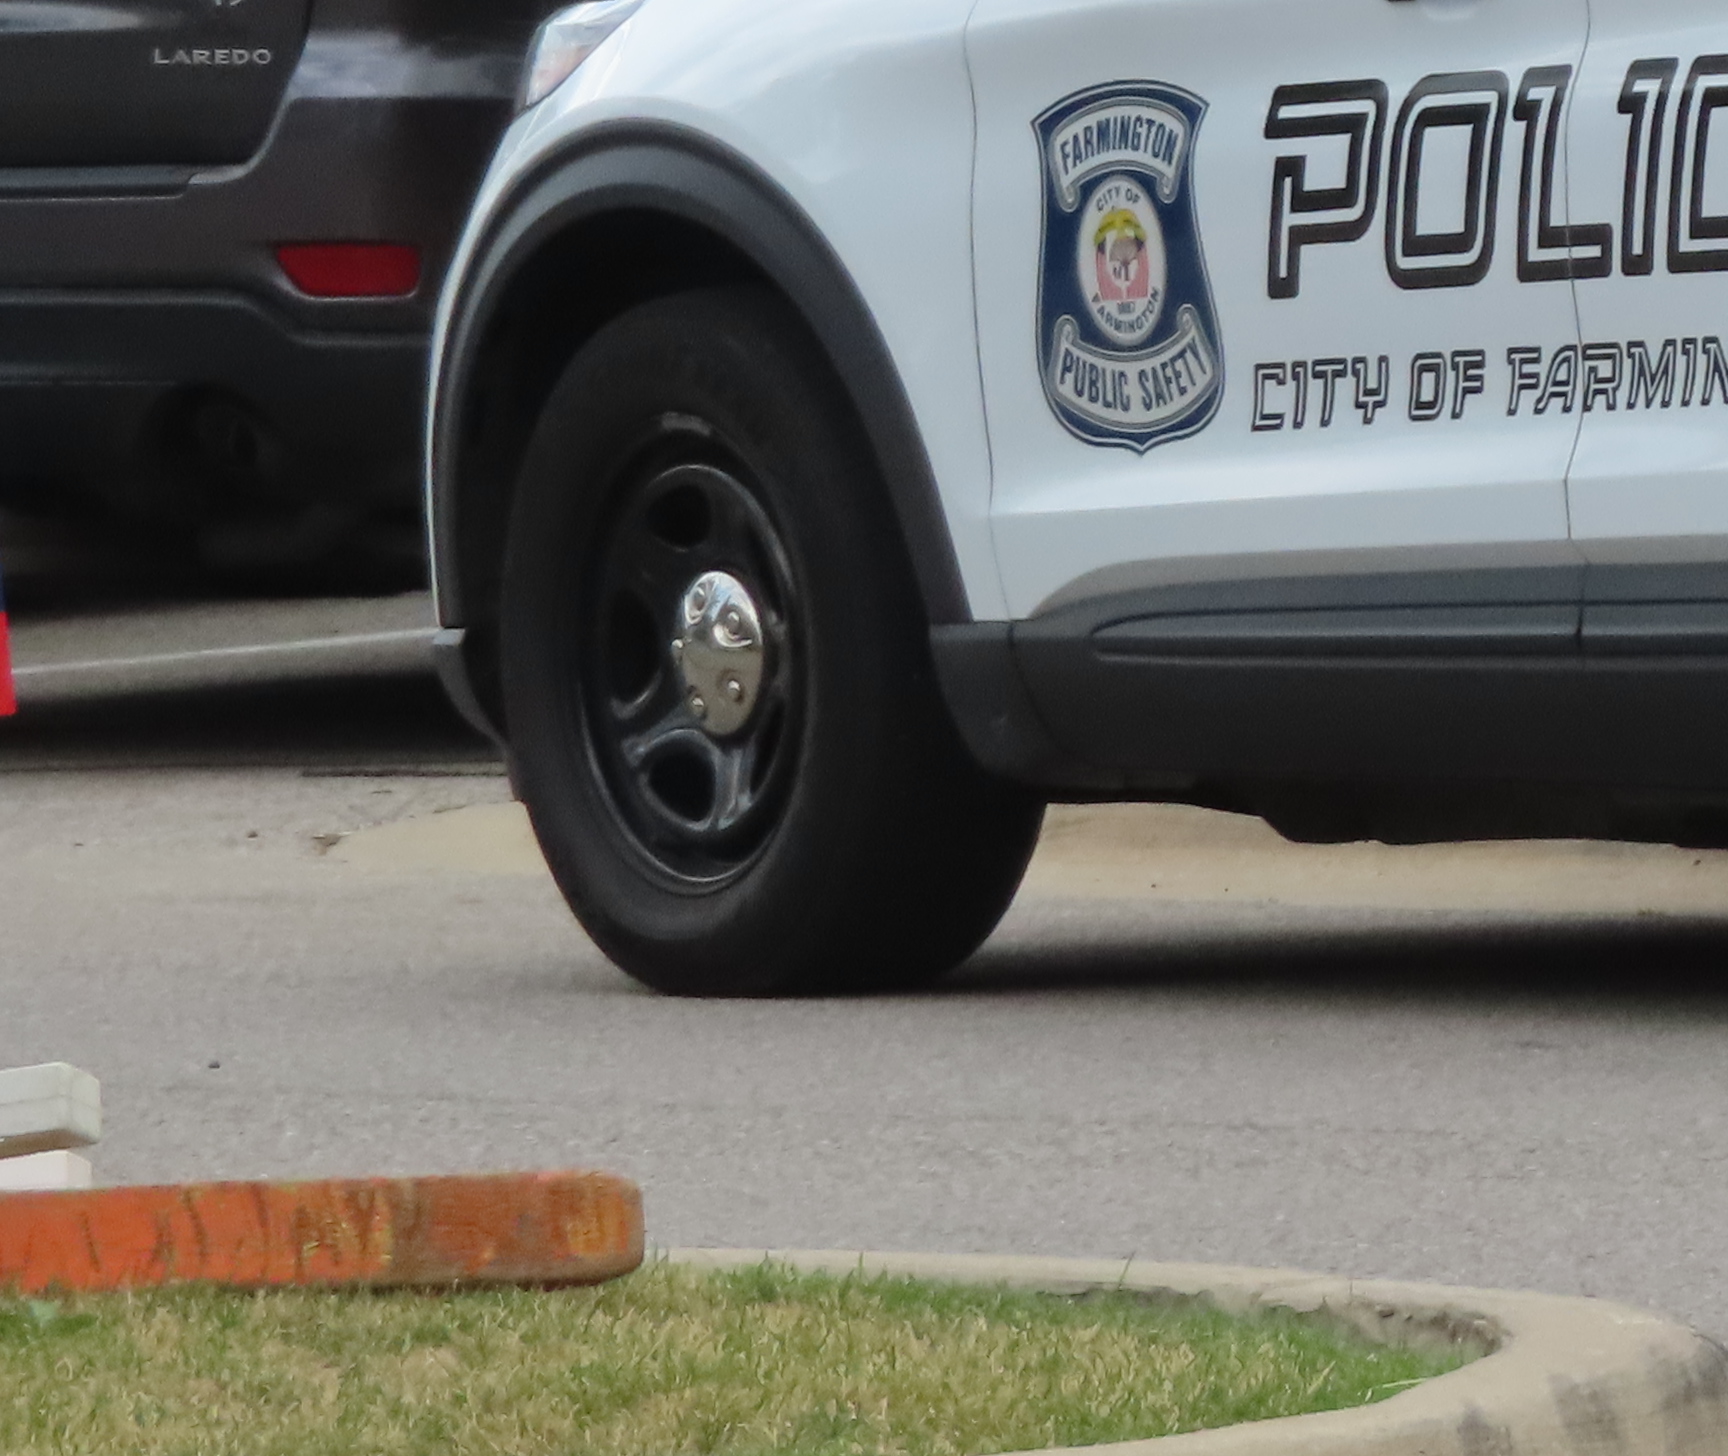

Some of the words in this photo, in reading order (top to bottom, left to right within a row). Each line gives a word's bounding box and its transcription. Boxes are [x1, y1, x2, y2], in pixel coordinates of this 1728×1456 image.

[153, 48, 272, 65] LAREDO
[1059, 114, 1180, 176] FARMINGTON
[1096, 185, 1121, 211] CITY
[1125, 187, 1141, 204] OF
[1060, 347, 1131, 412] PUBLIC
[1138, 335, 1208, 412] SAFETY
[1251, 355, 1389, 431] CITY
[1406, 348, 1486, 421] OF
